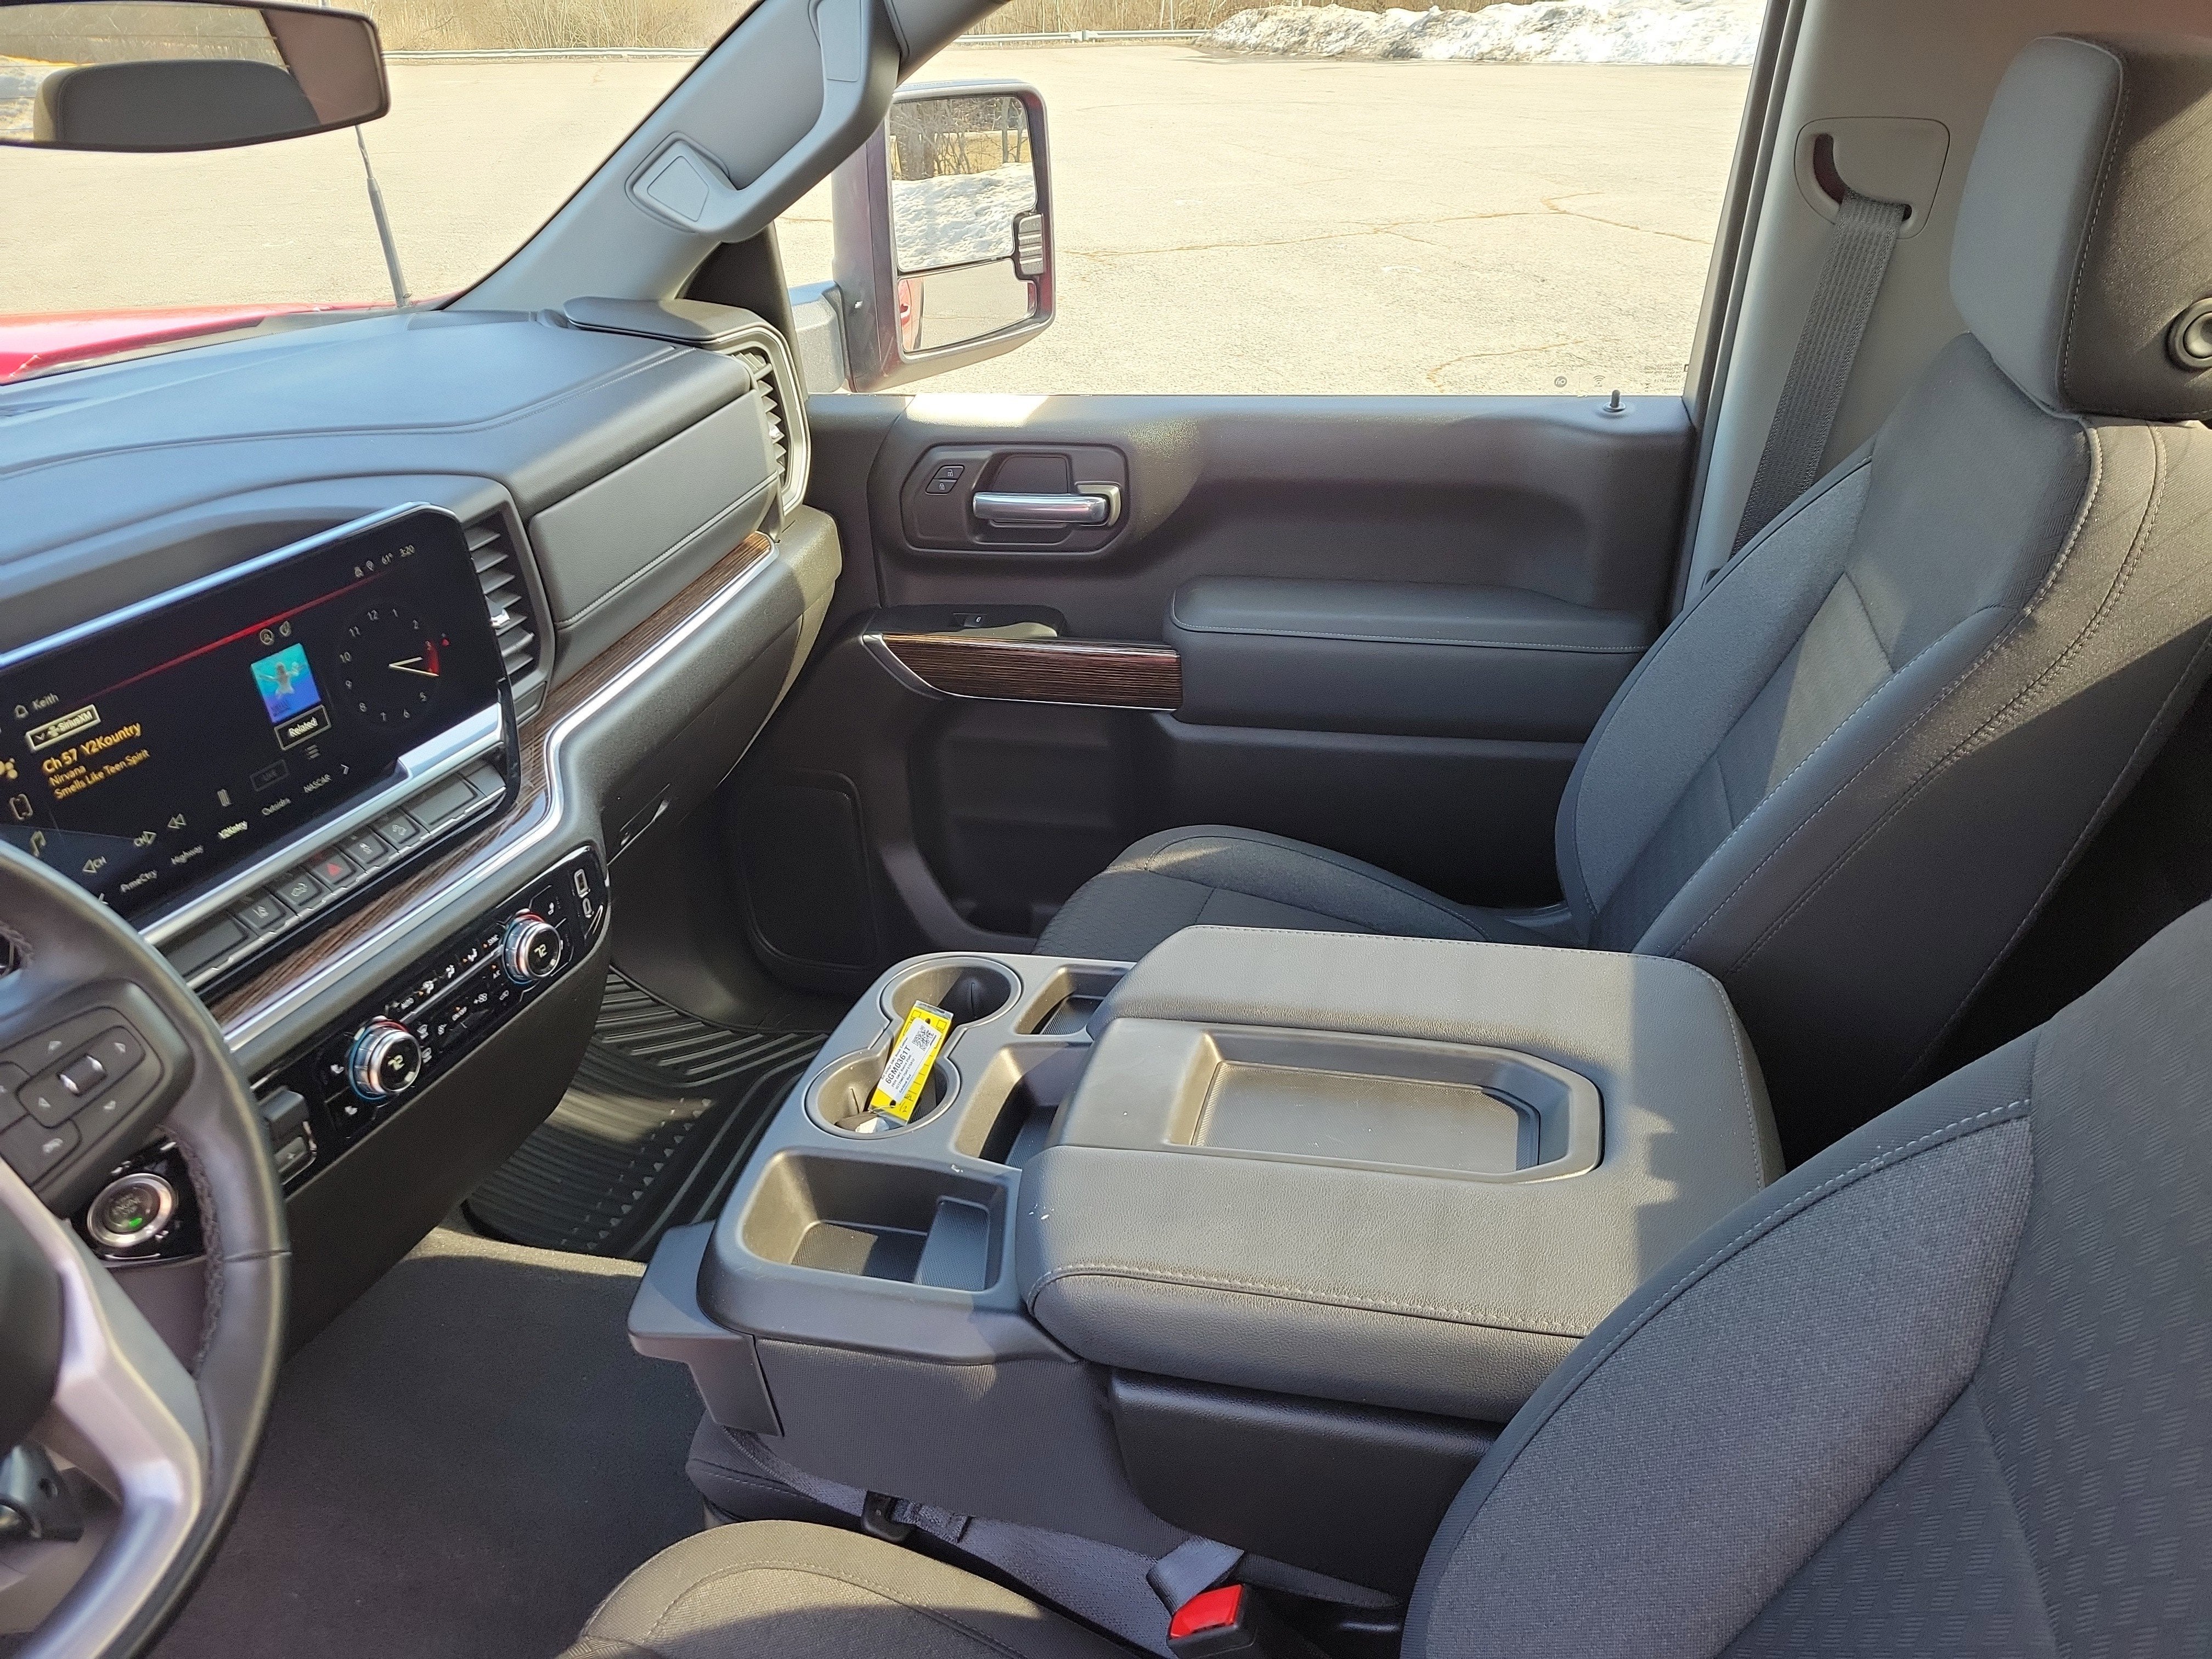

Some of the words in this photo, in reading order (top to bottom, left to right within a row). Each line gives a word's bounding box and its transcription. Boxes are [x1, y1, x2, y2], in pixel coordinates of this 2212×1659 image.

[368, 610, 379, 621] 12
[392, 608, 398, 618] 1
[413, 619, 419, 630] 2
[349, 626, 361, 638] 11
[340, 651, 351, 663] 10
[345, 680, 353, 690] 9
[32, 692, 59, 710] Keith
[420, 692, 427, 702] 5
[359, 702, 367, 712] 8
[403, 708, 410, 718] 6
[58, 710, 93, 732] SiriusXM
[288, 716, 318, 737] Related
[43, 757, 63, 773] Ch
[60, 748, 78, 765] 57
[81, 722, 142, 755] Y2Kountry
[48, 765, 86, 787] Nirvana
[54, 778, 87, 799] Smells
[85, 771, 105, 785] Like
[103, 760, 127, 775] Teen
[125, 748, 151, 766] Spirit
[170, 844, 204, 866] Highway
[303, 774, 332, 793] NASCAR
[92, 855, 107, 869] CH
[534, 944, 548, 958] 72
[387, 1054, 405, 1070] 72
[884, 1045, 911, 1084] 6GM0361T
